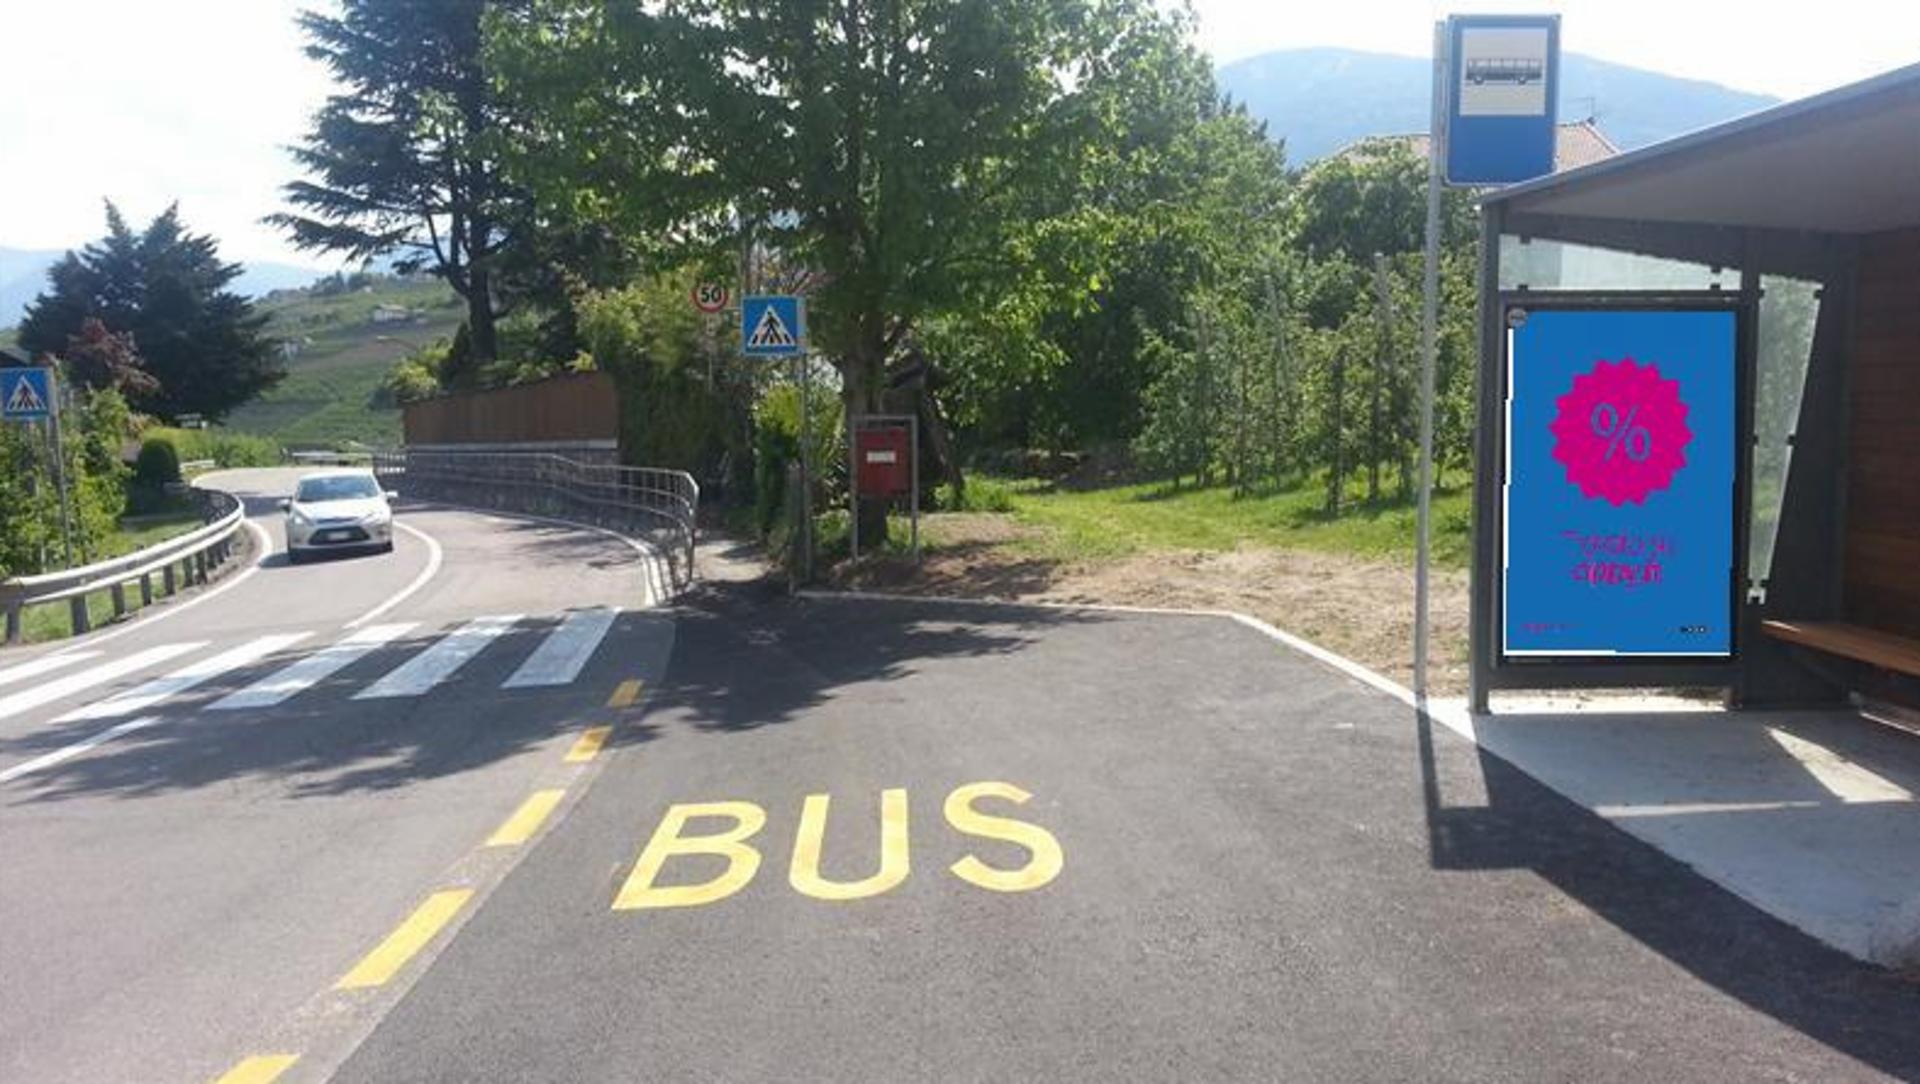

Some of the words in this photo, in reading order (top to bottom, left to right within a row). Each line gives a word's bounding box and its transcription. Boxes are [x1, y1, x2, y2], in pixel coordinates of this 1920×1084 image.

[700, 286, 722, 303] 50
[1590, 402, 1651, 464] %
[611, 780, 1065, 910] BUS
